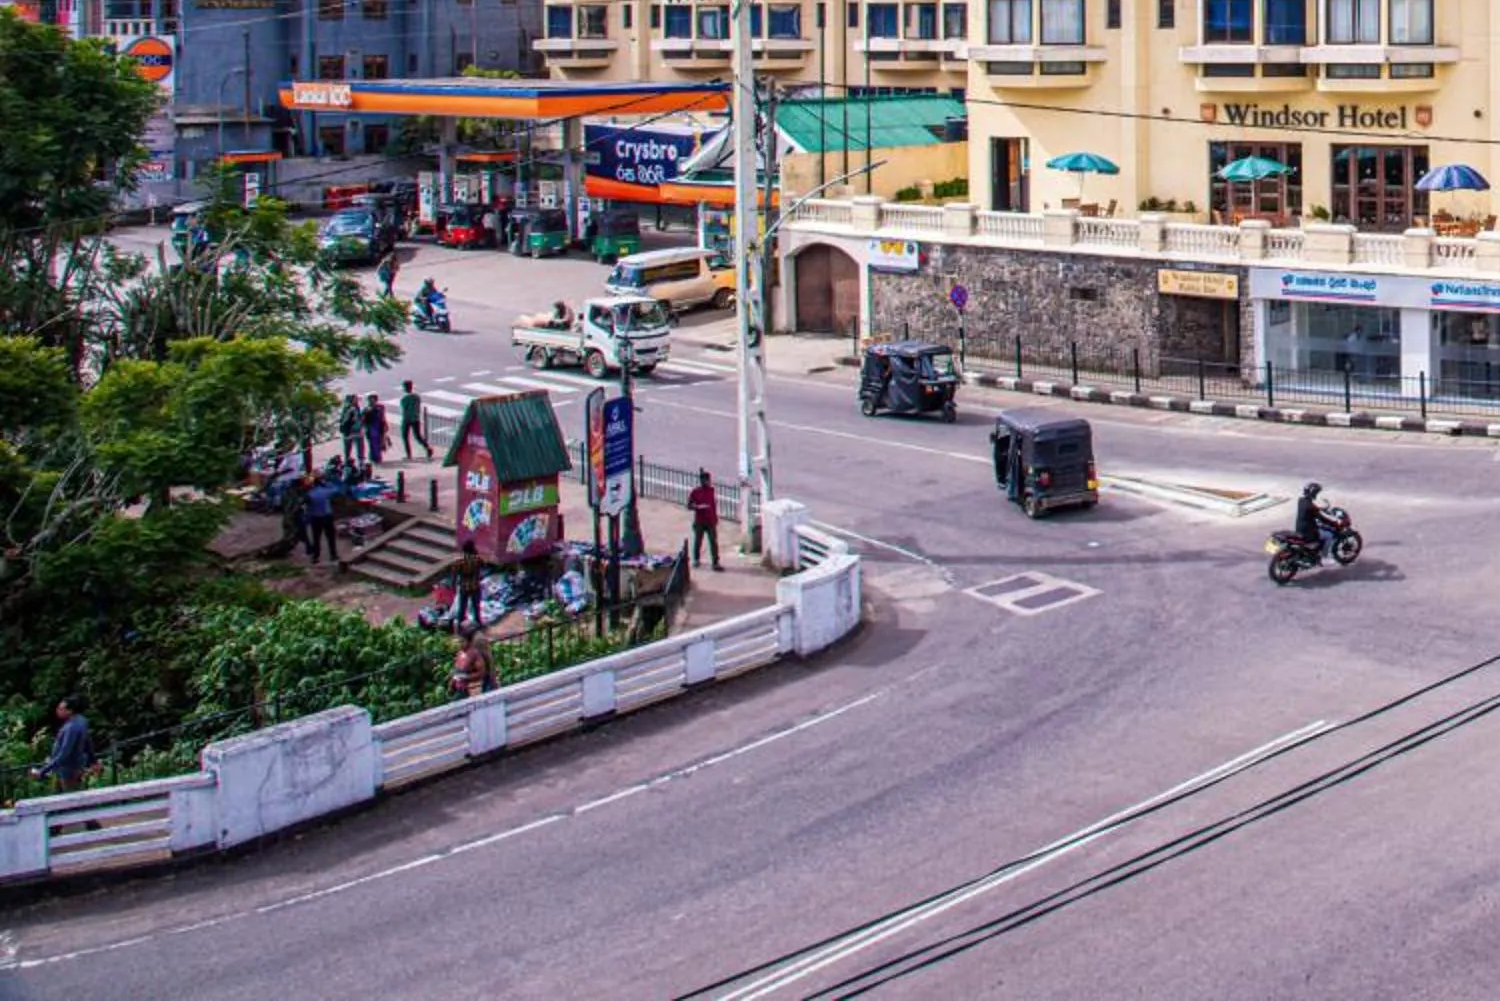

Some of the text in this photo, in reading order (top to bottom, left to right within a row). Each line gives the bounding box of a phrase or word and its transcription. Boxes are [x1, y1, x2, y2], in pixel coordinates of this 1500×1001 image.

[1224, 103, 1407, 129] Windsor Hotel
[615, 139, 678, 164] Crysbro
